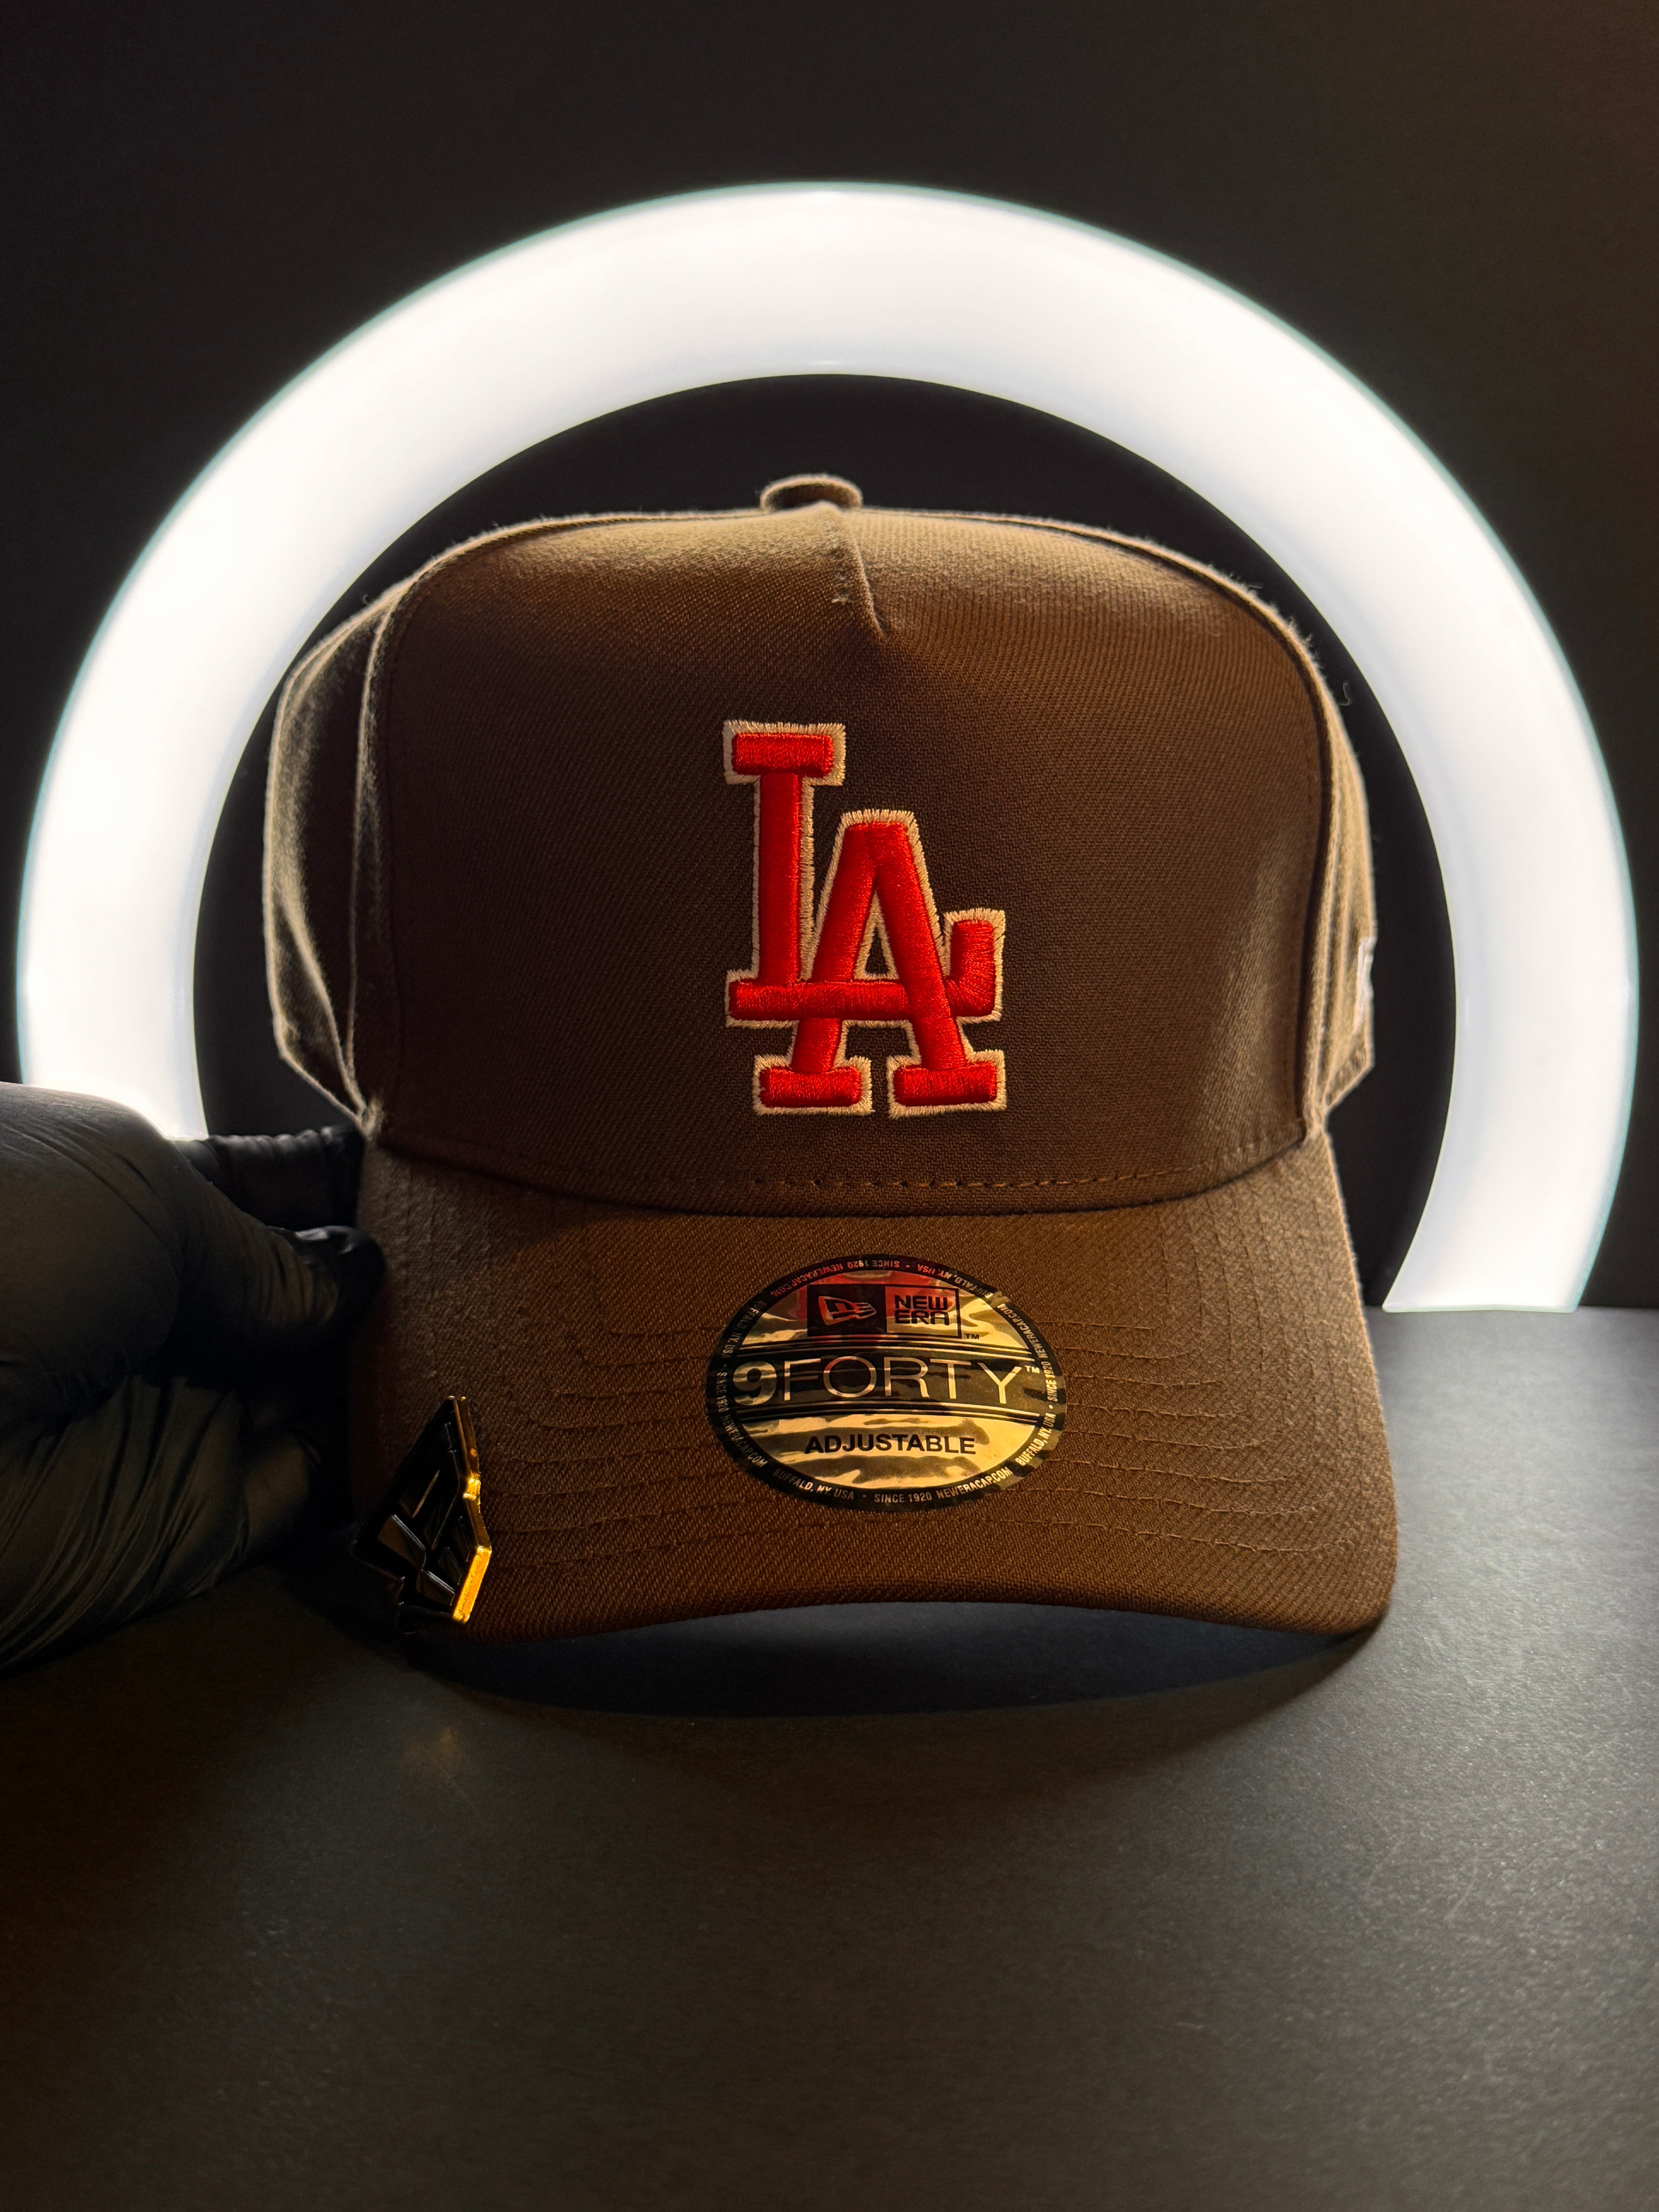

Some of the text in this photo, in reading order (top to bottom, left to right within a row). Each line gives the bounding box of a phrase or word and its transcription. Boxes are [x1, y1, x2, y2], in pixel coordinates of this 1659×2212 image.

[723, 721, 1007, 1118] LA
[847, 1260, 869, 1268] 1920
[872, 1260, 899, 1268] SINCE
[918, 1264, 935, 1274] USA
[894, 1295, 948, 1310] NEW
[895, 1309, 950, 1325] ERA
[997, 1303, 1048, 1358] NEWERACAP.COM
[1041, 1361, 1055, 1379] 1920
[1046, 1379, 1058, 1402] SINCE
[1043, 1412, 1056, 1427] USA
[804, 1434, 976, 1455] ADJUSTABLE
[834, 1488, 854, 1500] USA
[874, 1493, 905, 1503] SINCE
[908, 1492, 932, 1502] 1920
[935, 1466, 1013, 1499] NEWERACAP.COM
